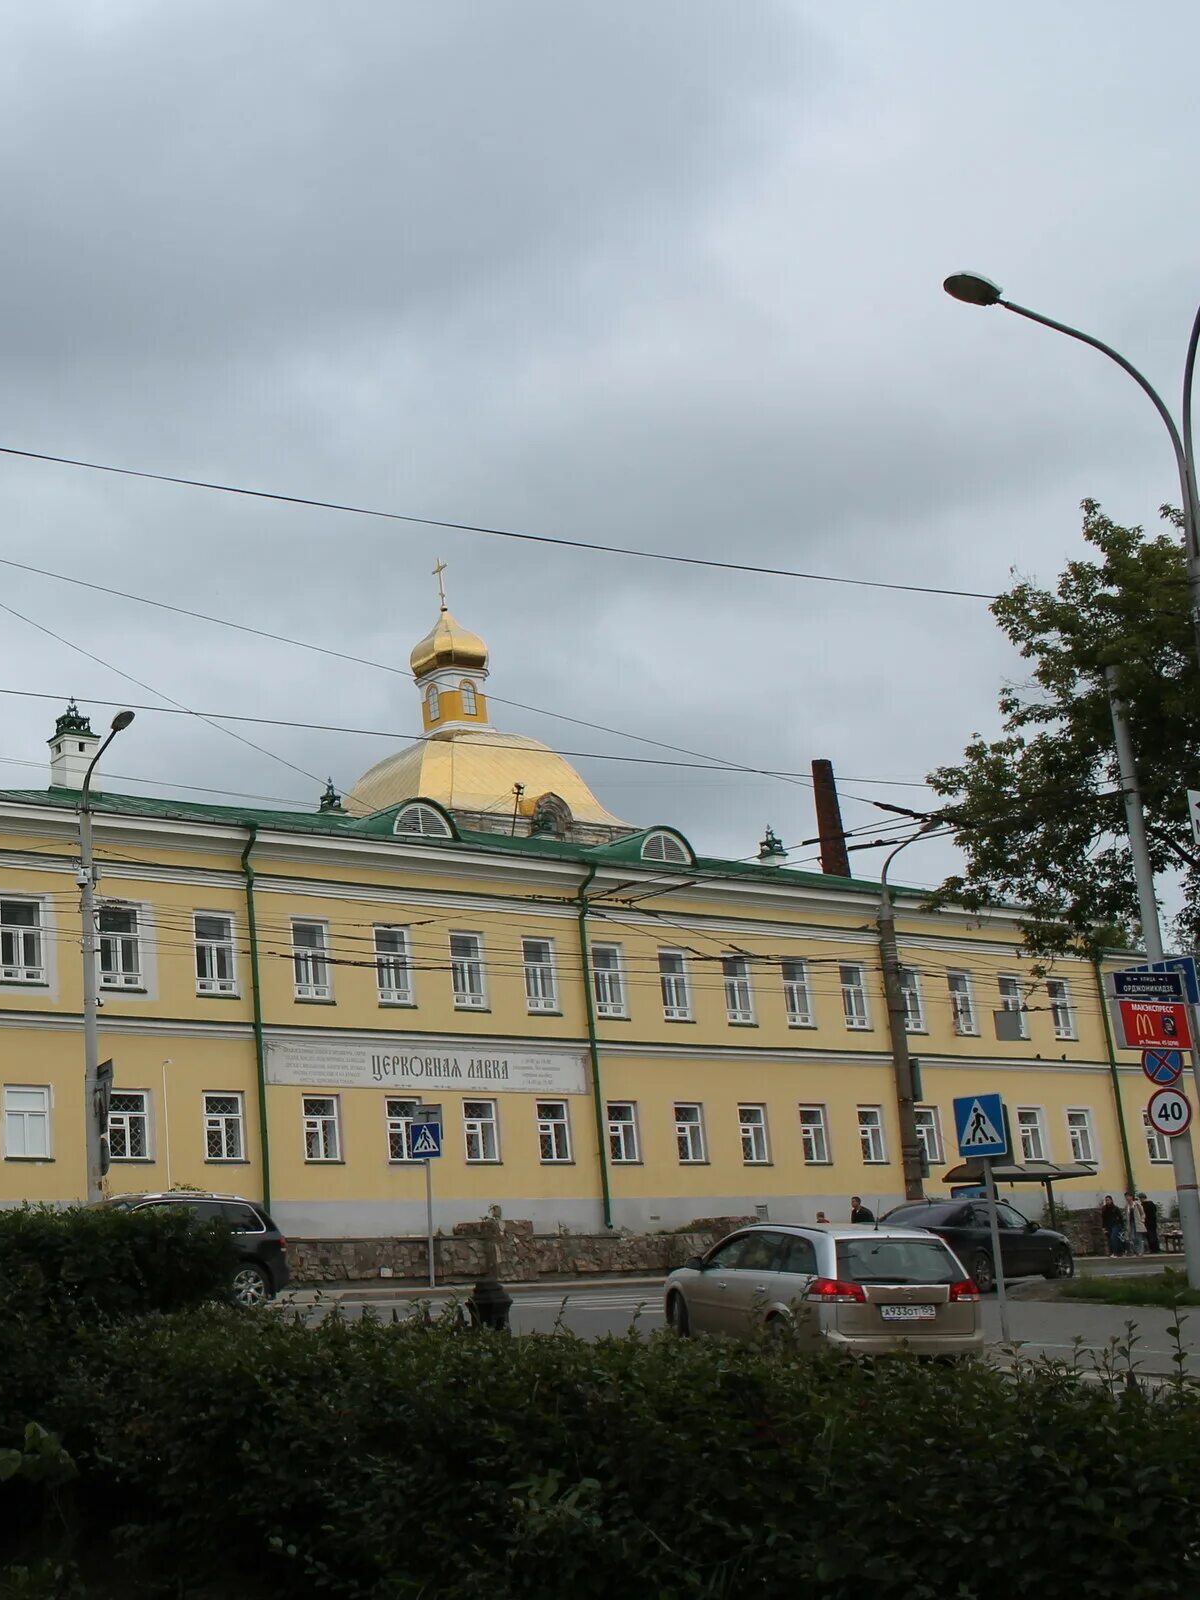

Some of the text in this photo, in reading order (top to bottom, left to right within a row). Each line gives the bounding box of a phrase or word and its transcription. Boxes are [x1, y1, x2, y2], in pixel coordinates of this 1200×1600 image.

[1123, 985, 1174, 993] ОРДЖОНИКИДЗЕ
[1131, 1003, 1174, 1013] МАКЭКСПРЕСС
[371, 1055, 509, 1081] ЦЕРКОВНАЯ ЛАВКА
[1158, 1102, 1182, 1121] 40
